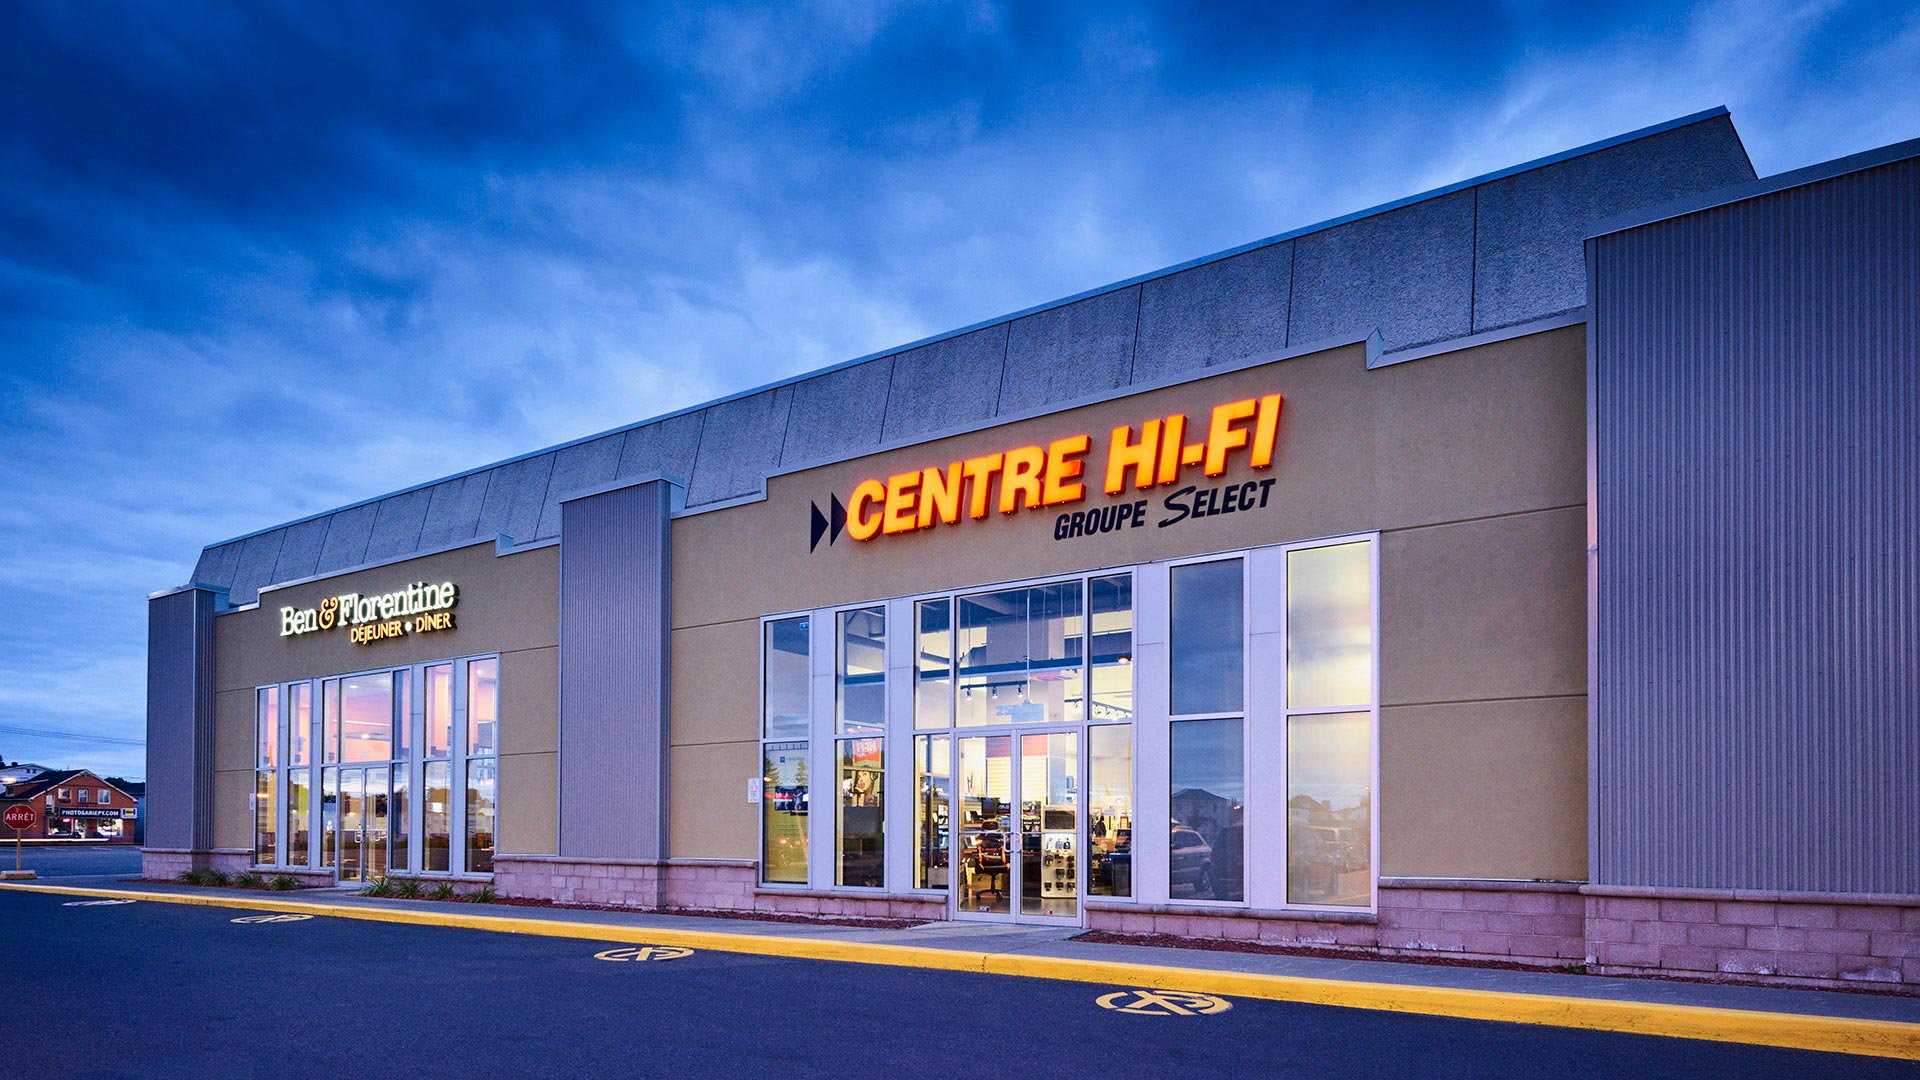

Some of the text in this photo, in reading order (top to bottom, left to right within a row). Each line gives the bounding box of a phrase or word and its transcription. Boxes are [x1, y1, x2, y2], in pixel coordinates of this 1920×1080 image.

[846, 394, 1283, 542] CENTRE HI-FI
[1053, 478, 1276, 541] GROUPE SELECT
[280, 581, 455, 636] Ben & Florentine
[350, 612, 452, 645] DÉJEUNER DÎNER
[5, 812, 35, 821] ARRÊT
